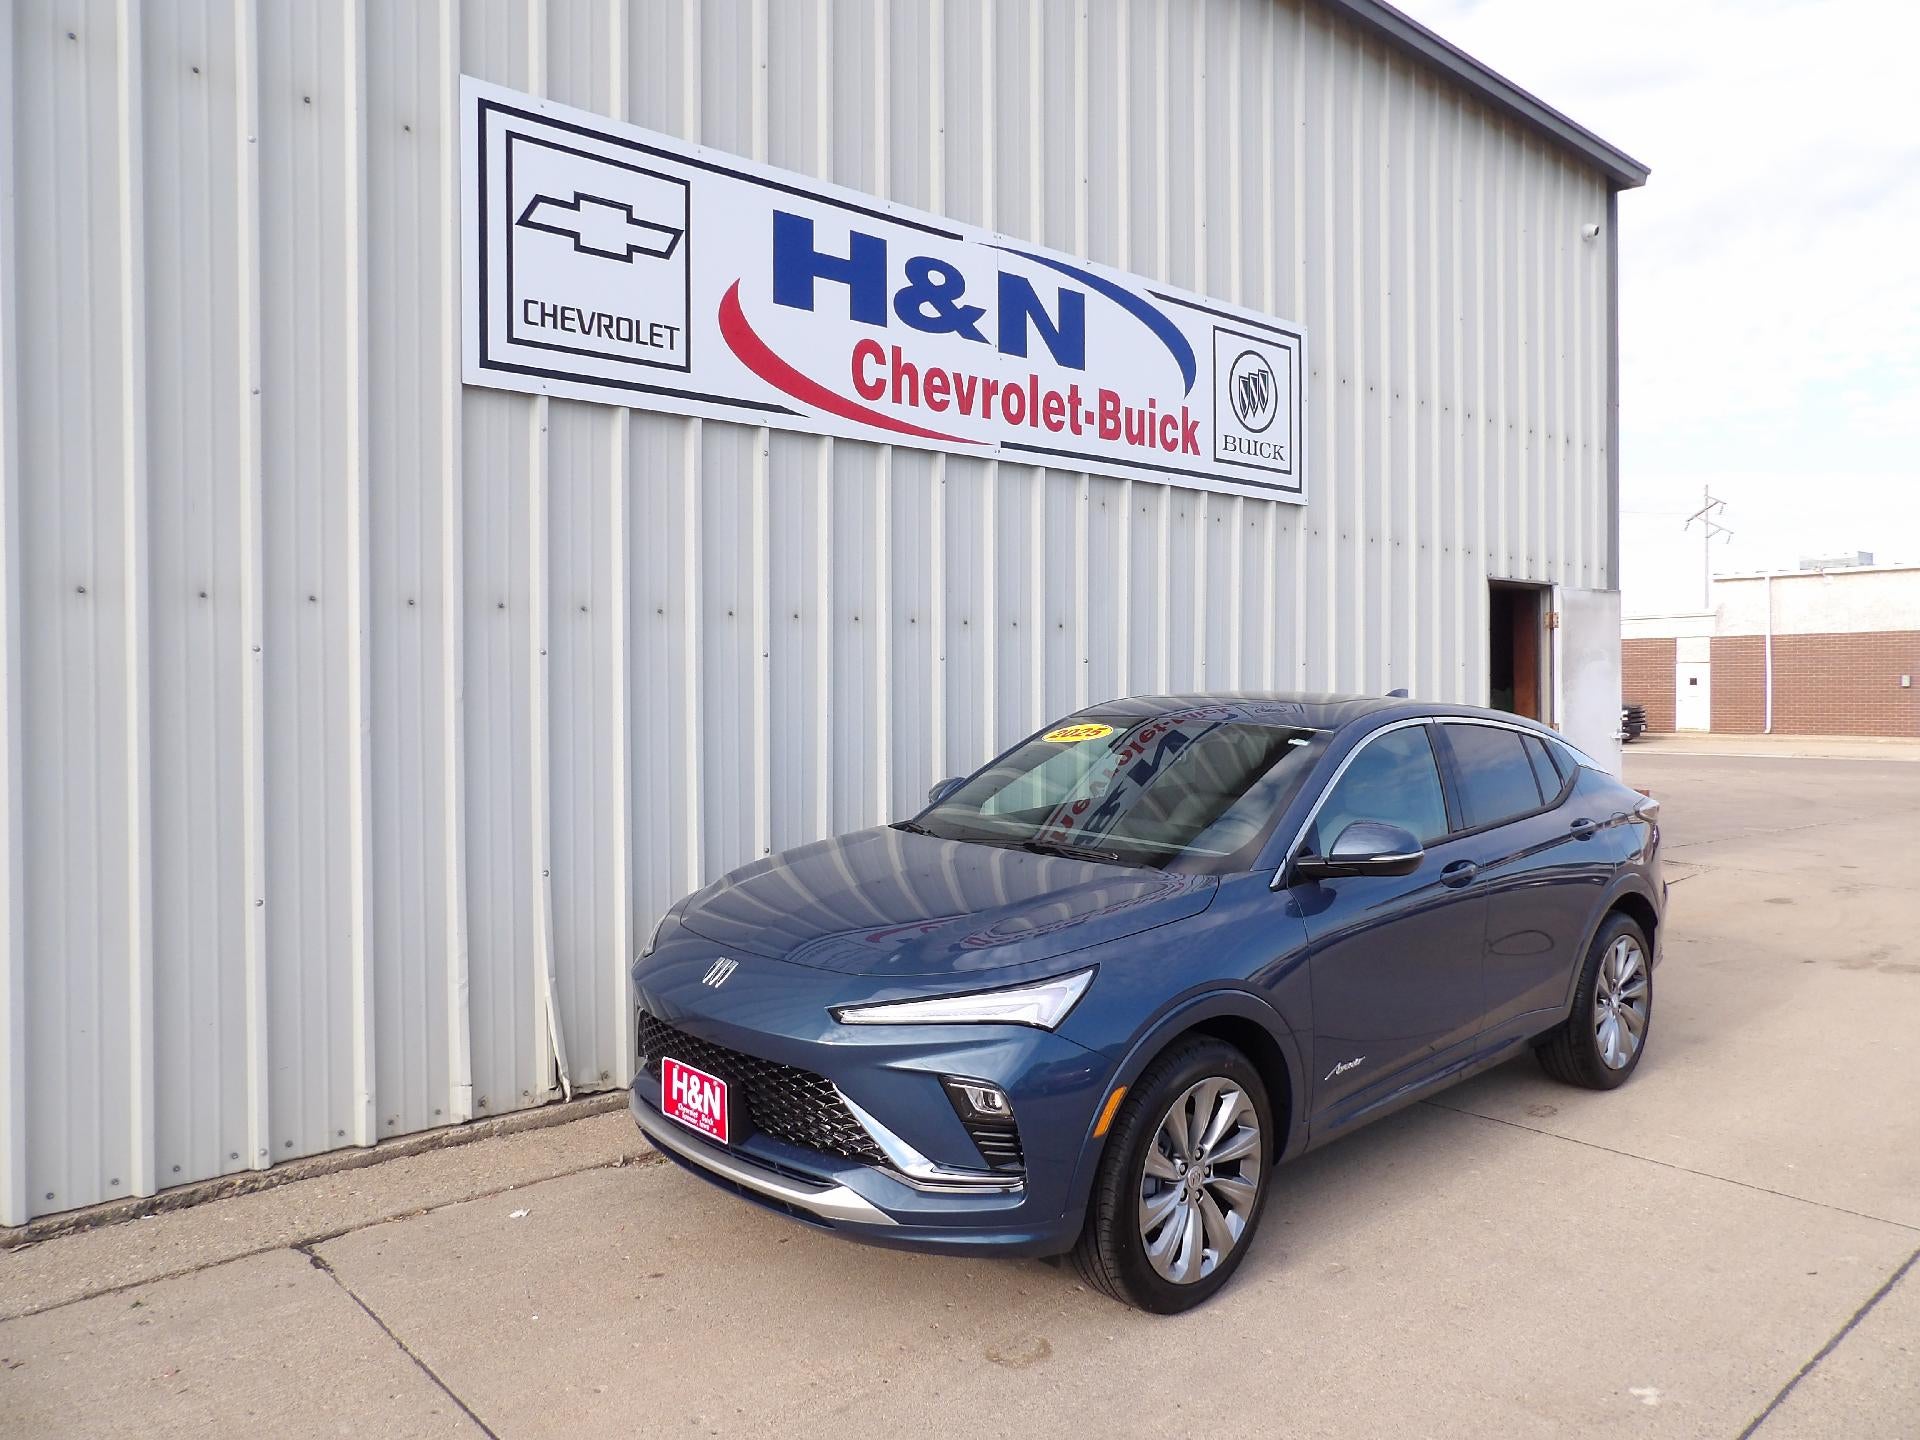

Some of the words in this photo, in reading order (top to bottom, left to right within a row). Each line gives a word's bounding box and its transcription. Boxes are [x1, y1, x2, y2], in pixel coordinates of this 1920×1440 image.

[773, 209, 1086, 371] H&N
[523, 299, 680, 351] CHEVROLET
[851, 338, 1201, 457] Chevrolet-Buick
[1222, 434, 1286, 462] BUICK
[1046, 726, 1109, 739] 2025
[672, 1067, 721, 1120] H&N
